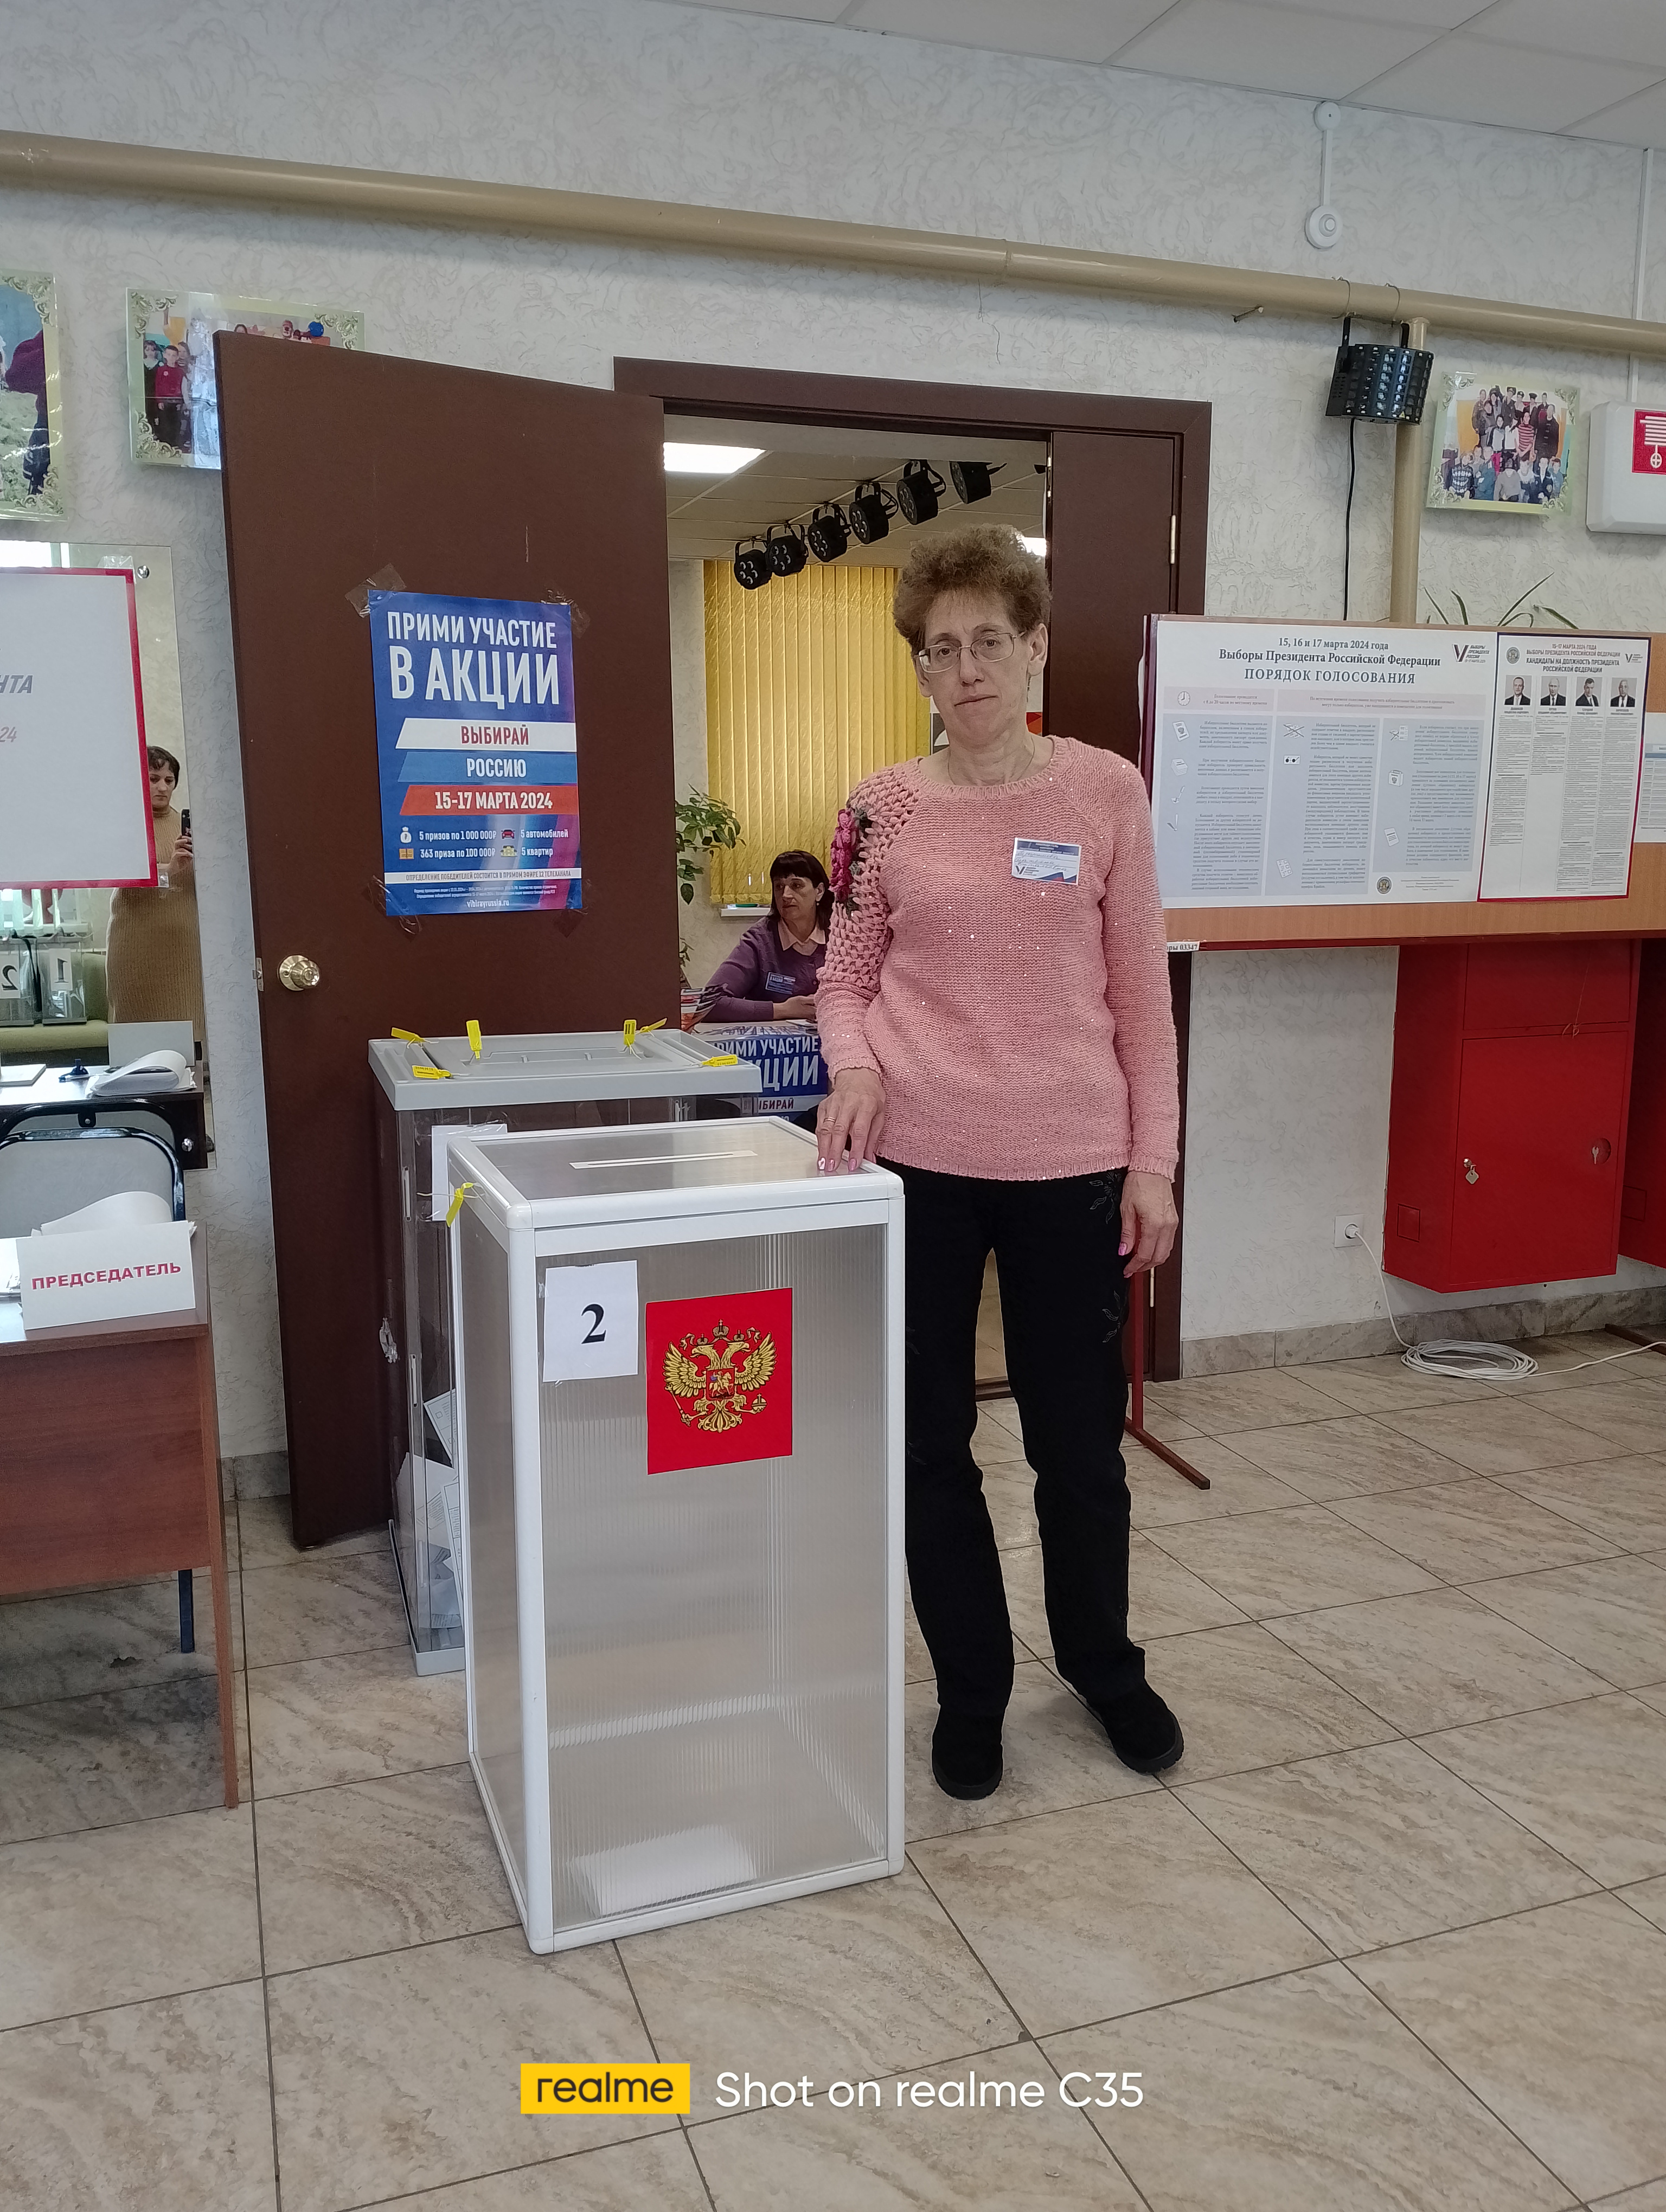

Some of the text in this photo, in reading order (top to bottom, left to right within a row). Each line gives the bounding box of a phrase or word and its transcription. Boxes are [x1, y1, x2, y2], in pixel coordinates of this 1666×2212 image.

[387, 611, 558, 649] ПРИМИ УЧАСТИЕ
[1279, 638, 1291, 648] 15,
[1293, 639, 1303, 647] 16
[1312, 639, 1322, 647] 17
[1323, 641, 1348, 651] марта
[1350, 640, 1369, 649] 2024
[1371, 642, 1389, 651] года
[1219, 649, 1441, 669] Выборы Президента Российской Федерации
[390, 645, 560, 710] В АКЦИИ
[1244, 668, 1415, 685] ПОРЯДОК ГОЛОСОВАНИЯ
[461, 724, 529, 747] ВЫБИРАЙ
[466, 757, 527, 779] РОССИЮ
[435, 791, 553, 810] 15-17 МАРТА 2024
[419, 831, 424, 840] 5
[425, 832, 450, 843] призов
[521, 828, 568, 839] 5 автомобилей
[420, 849, 433, 858] 363
[434, 850, 455, 860] приза
[456, 850, 465, 858] по
[522, 847, 553, 858] 5 квартир
[440, 872, 473, 880] ПОБЕДИТЕЛЕЙ
[713, 1036, 819, 1057] РИМИ УЧАСТИЕ
[759, 1097, 794, 1110] БИРАЙ
[31, 1262, 181, 1290] ПРЕДСЕДАТЕЛЬ
[581, 1303, 607, 1345] 2
